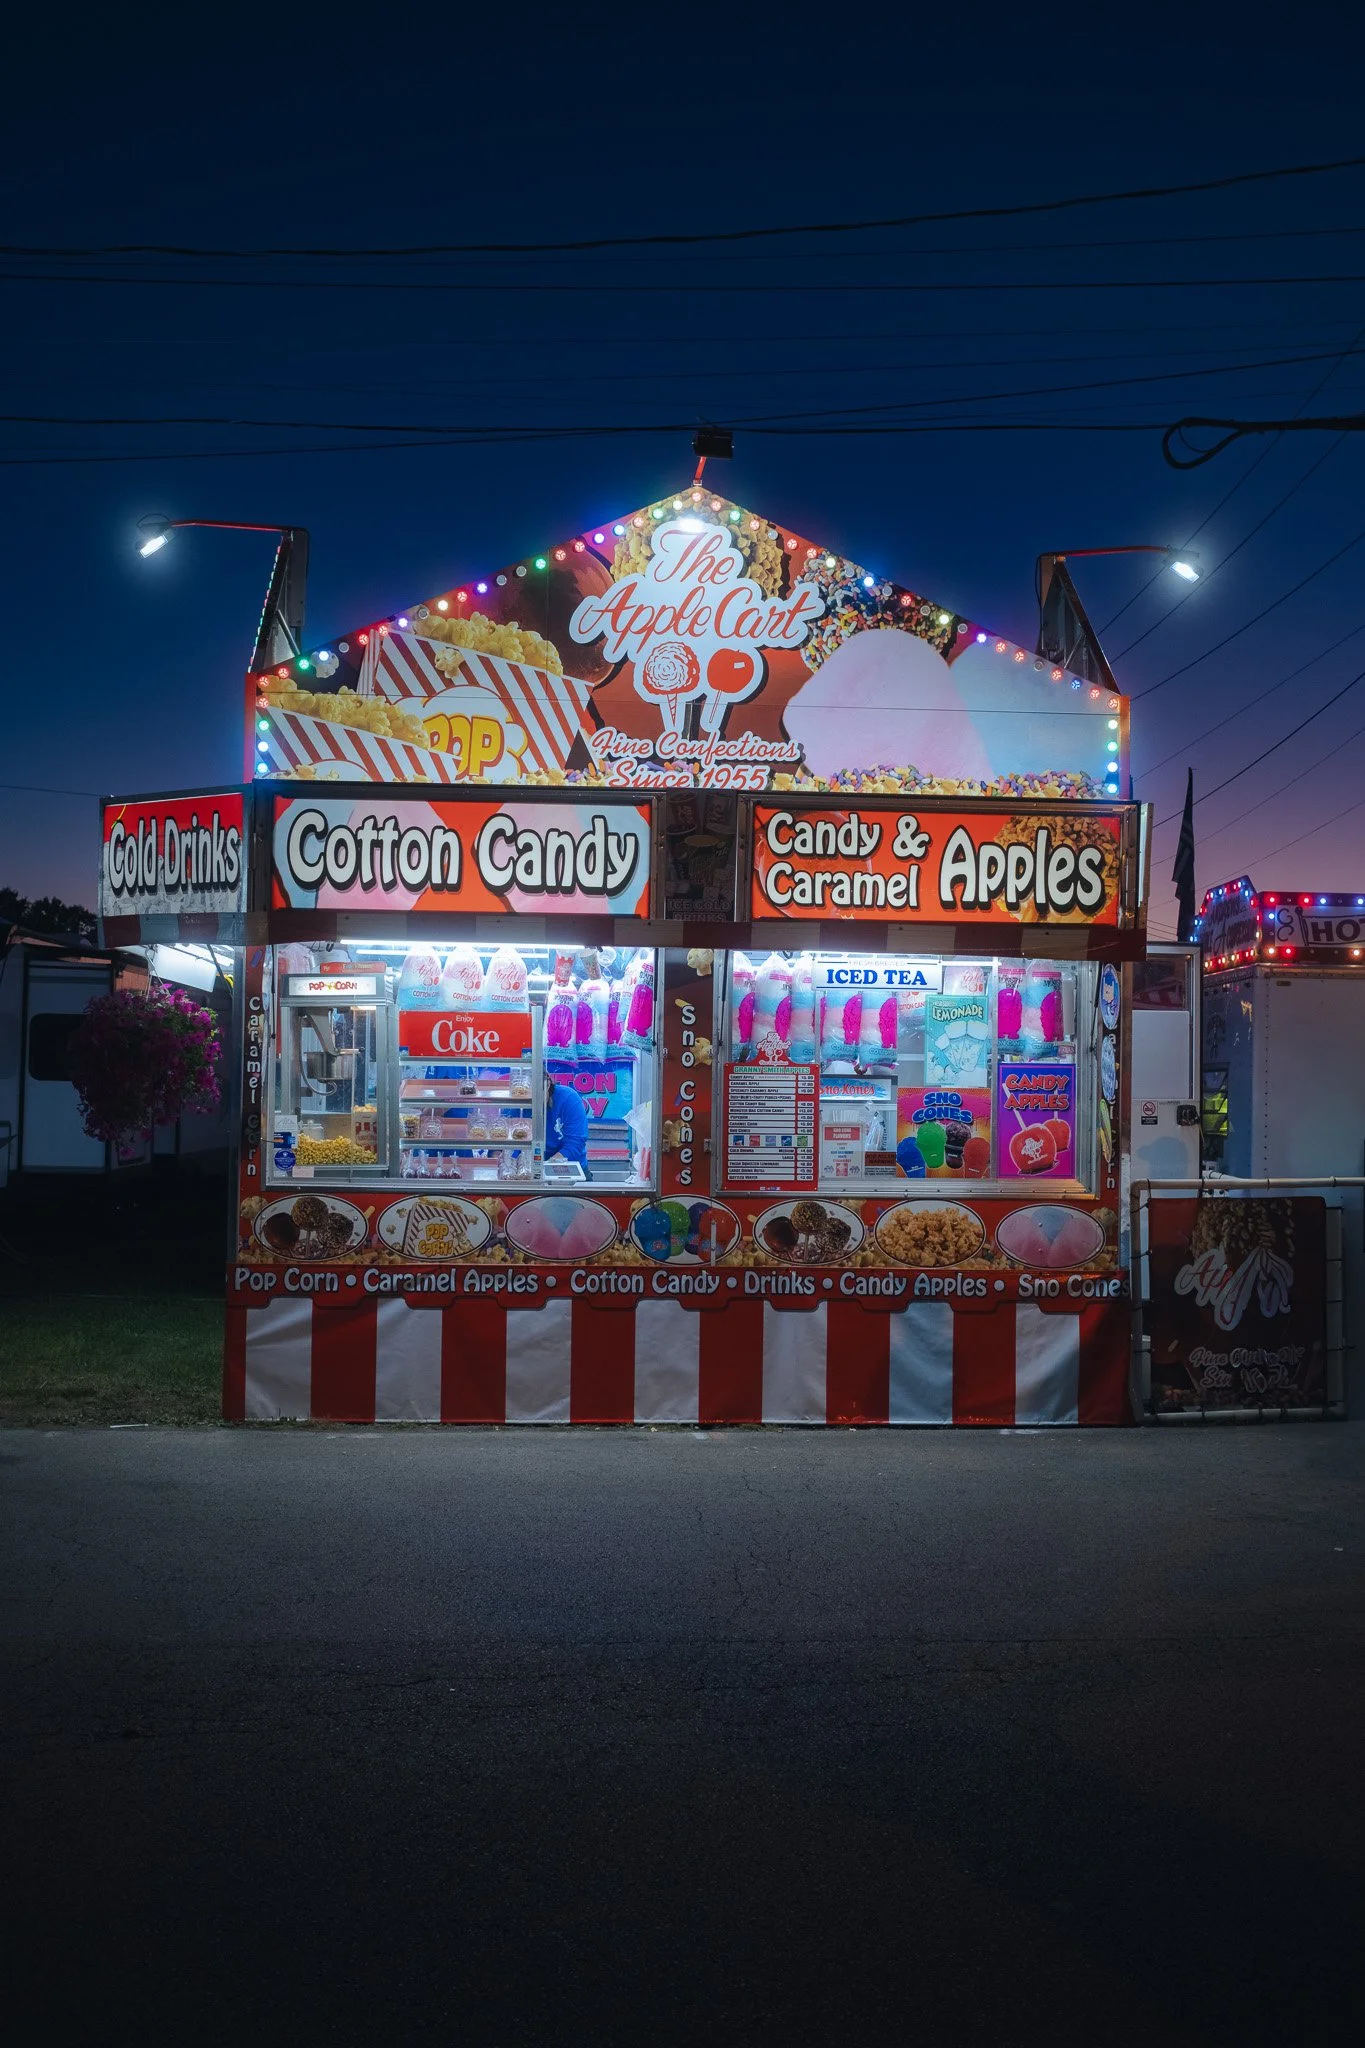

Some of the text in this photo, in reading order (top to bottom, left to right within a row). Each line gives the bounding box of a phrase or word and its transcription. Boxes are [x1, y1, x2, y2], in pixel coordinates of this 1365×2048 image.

[654, 529, 735, 584] The
[577, 582, 817, 654] Apple Cart
[592, 729, 798, 765] Fine Confections
[609, 759, 768, 790] Since 1955
[109, 810, 241, 894] Cold Drinks
[286, 808, 461, 892] Cotton
[476, 813, 640, 895] Candy
[765, 811, 882, 859] Candy
[891, 814, 932, 861] &
[765, 861, 921, 910] Caramel
[938, 824, 1106, 913] Apples
[1311, 920, 1365, 942] HO
[826, 968, 928, 986] ICED TEA
[455, 1015, 474, 1023] Enjoy
[932, 1003, 983, 1022] LEMONADE
[247, 996, 261, 1104] Caramel
[431, 1019, 500, 1053] Coke
[681, 1004, 696, 1068] Sno
[923, 1091, 961, 1107] SNO
[1004, 1074, 1069, 1091] CANDY
[912, 1107, 973, 1123] CONES
[1005, 1093, 1069, 1110] APPLES
[679, 1081, 695, 1186] Cones
[426, 1223, 449, 1241] POP
[234, 1268, 1130, 1298] Pop Corn Caramel Apples Cotton Candy Drinks Candy Apples Sno Cones
